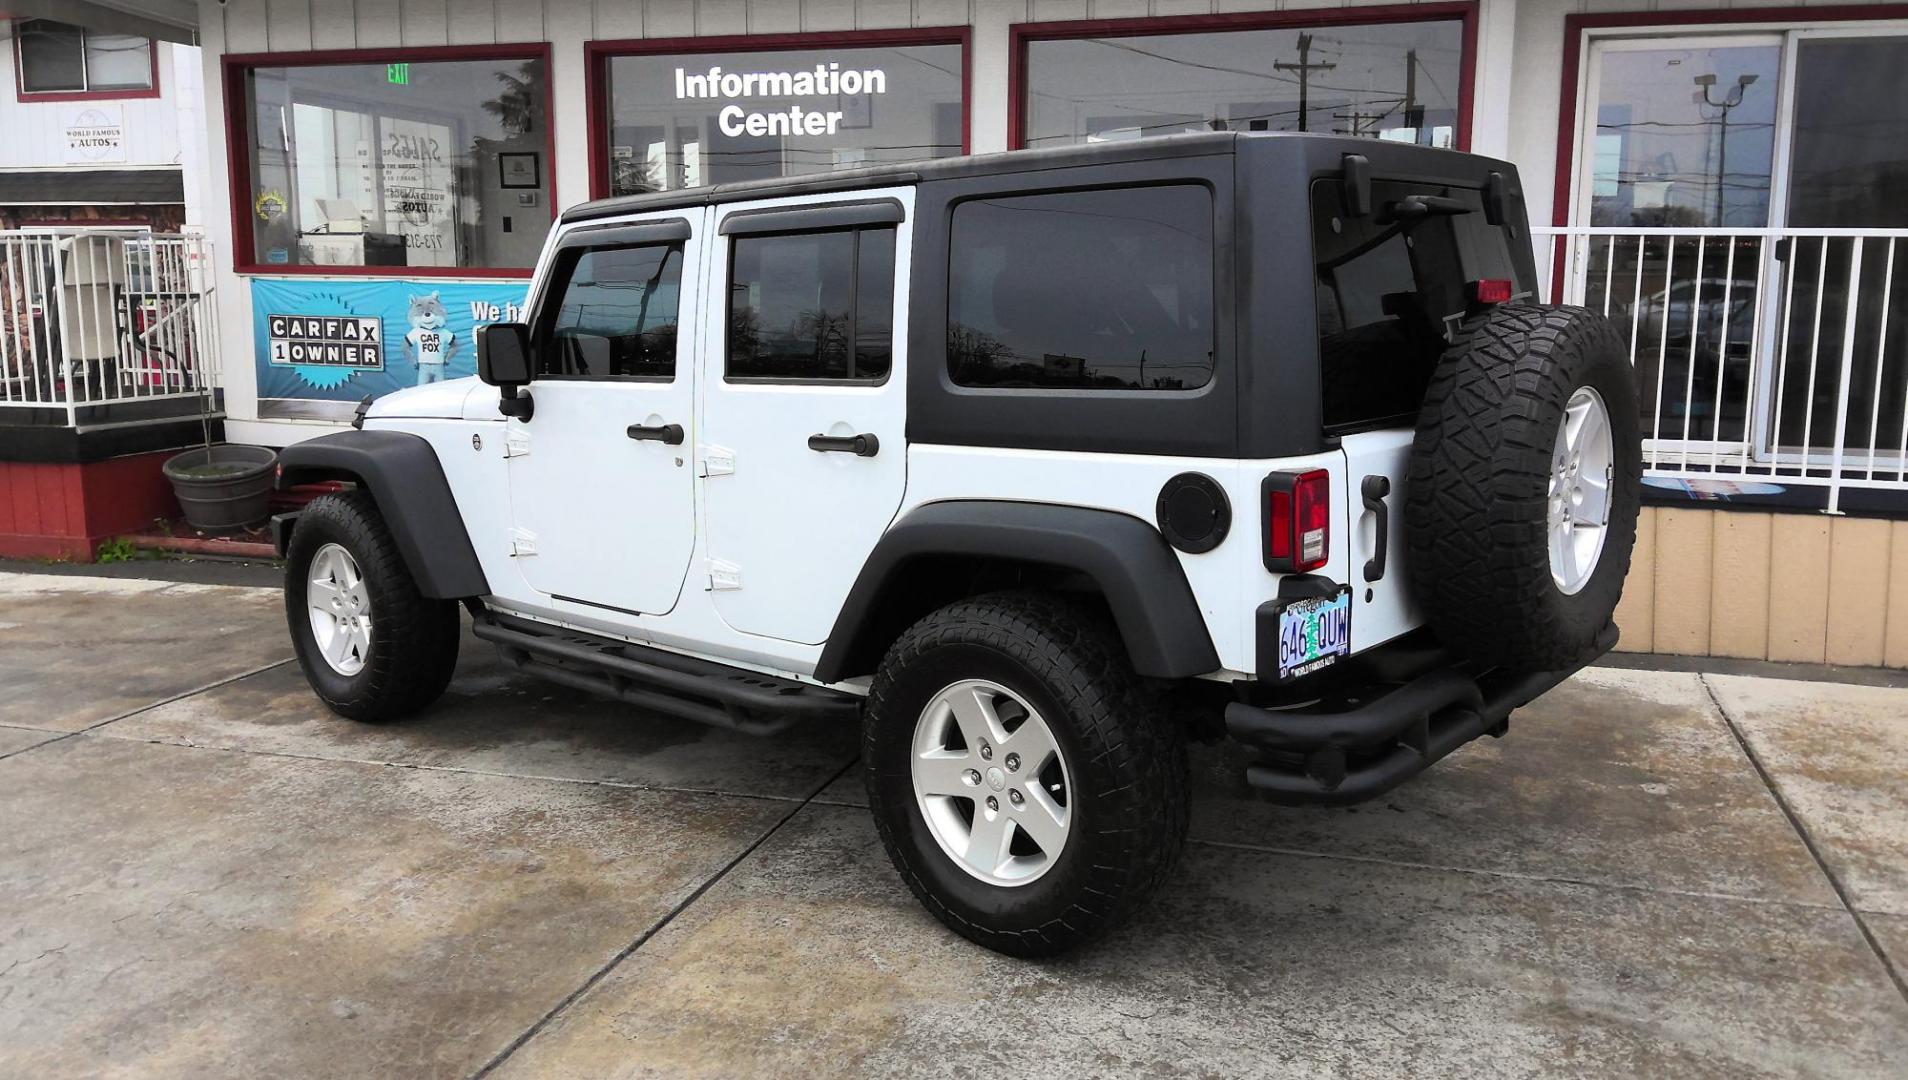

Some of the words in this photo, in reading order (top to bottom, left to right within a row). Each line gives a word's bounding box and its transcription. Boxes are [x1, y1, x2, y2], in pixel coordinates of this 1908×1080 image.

[387, 63, 408, 85] EXIT
[675, 63, 886, 98] Information
[718, 104, 843, 137] Center
[79, 138, 110, 147] AUTOS
[470, 301, 500, 321] We
[506, 302, 525, 321] ha
[273, 319, 375, 341] CARFAX
[420, 333, 439, 343] CAR
[422, 344, 439, 353] FOX
[1280, 619, 1307, 665] 646
[1317, 606, 1347, 650] QUW
